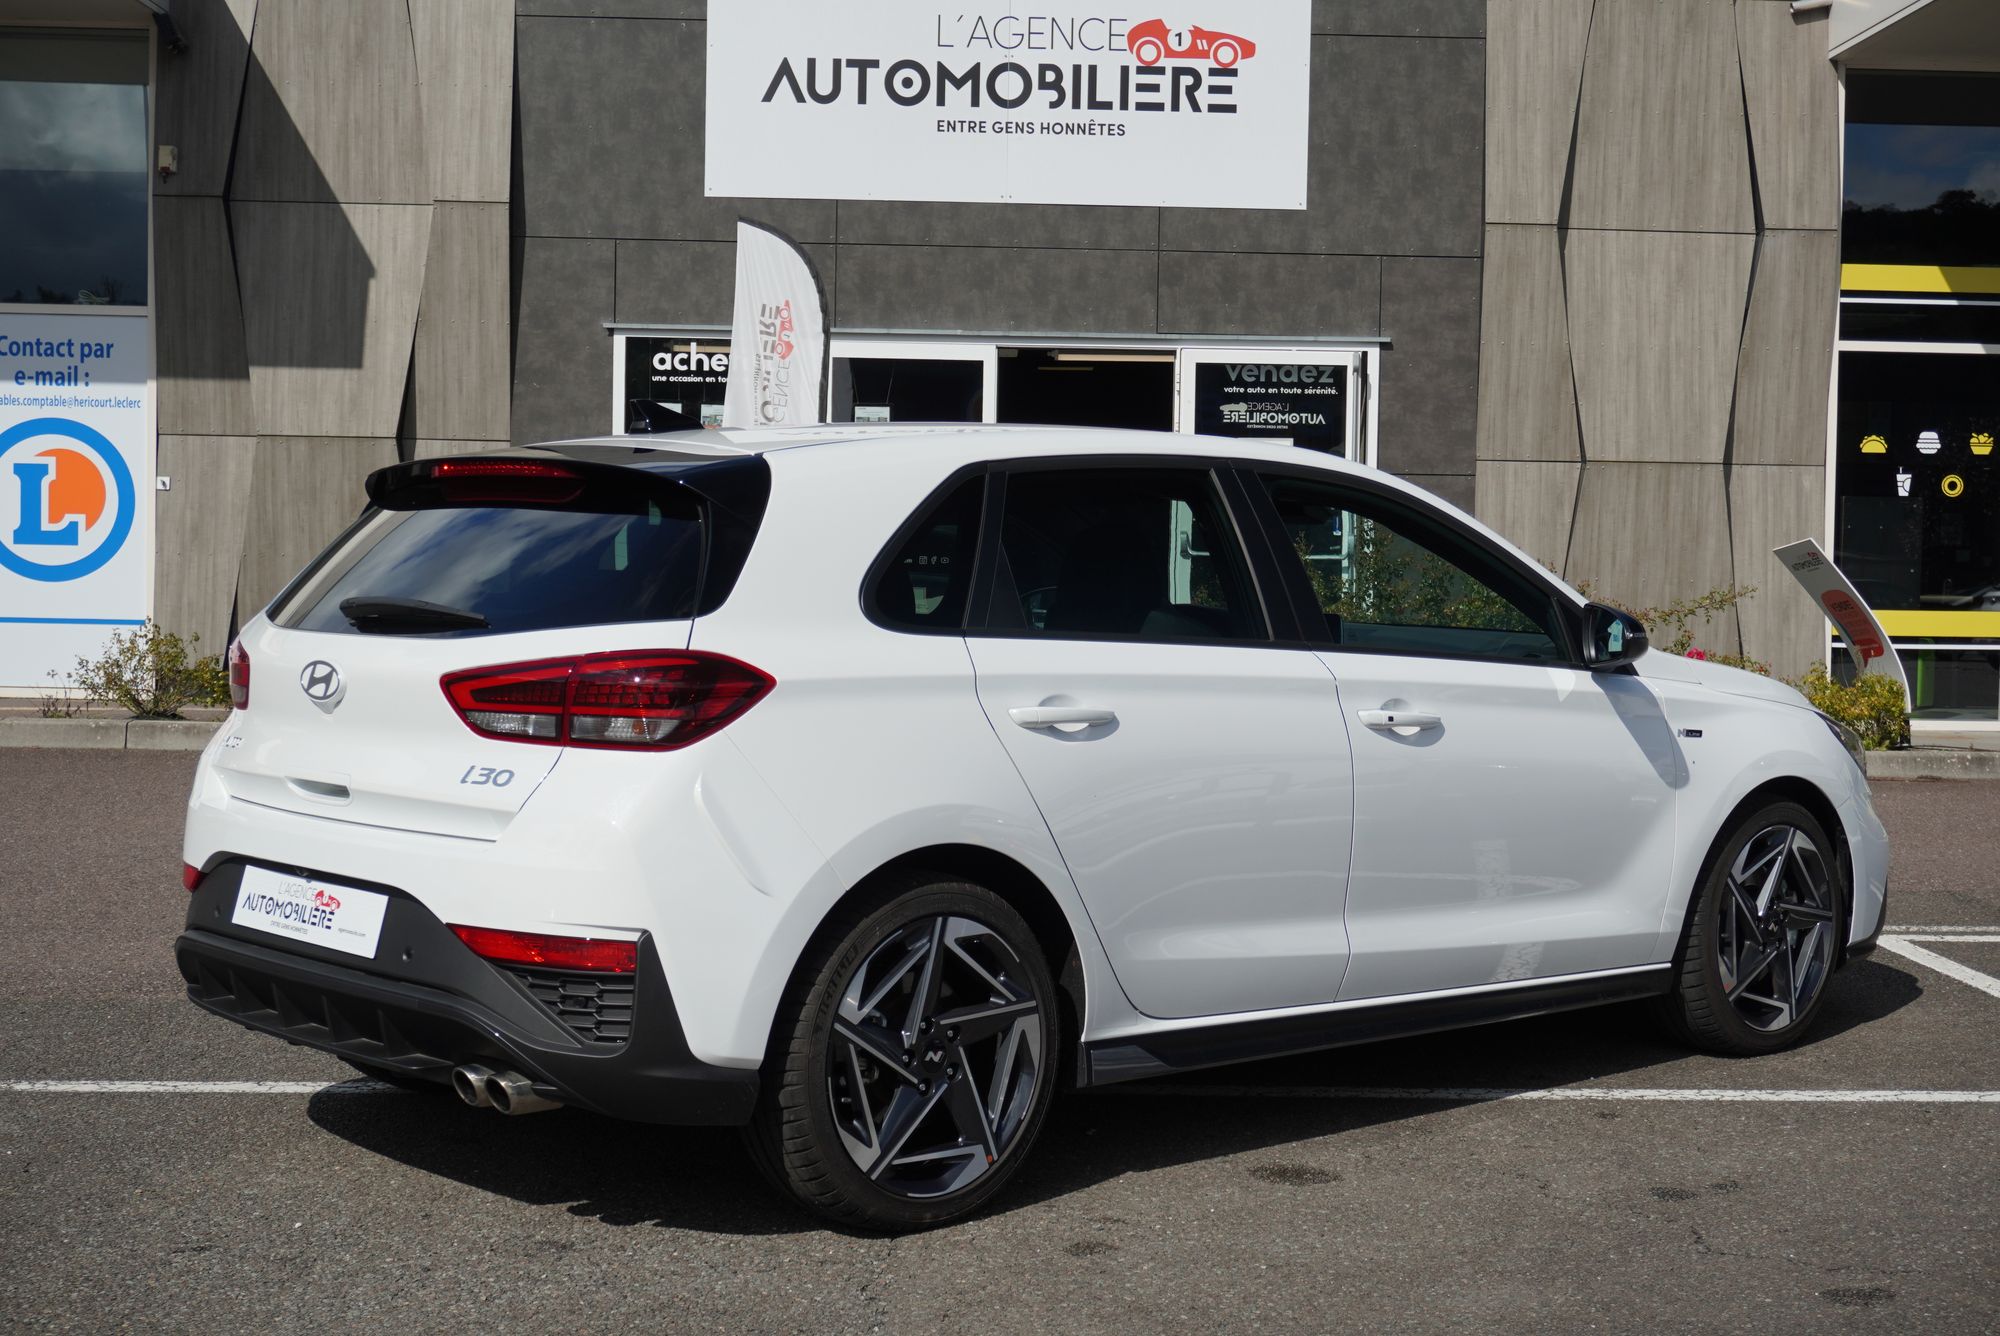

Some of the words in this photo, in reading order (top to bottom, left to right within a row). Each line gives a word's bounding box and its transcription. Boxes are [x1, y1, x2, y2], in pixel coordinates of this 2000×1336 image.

[936, 13, 1128, 52] L'AGENCE
[936, 119, 987, 134] ENTRE
[991, 120, 1035, 135] GENS
[1039, 118, 1127, 136] HONNÊTES
[0, 335, 75, 358] Contact
[79, 341, 114, 364] par
[652, 342, 730, 372] ache
[14, 365, 79, 387] e-mail
[669, 374, 704, 383] occasion
[718, 375, 729, 383] to
[1223, 385, 1245, 394] votre
[1246, 386, 1266, 394] auto
[1280, 386, 1302, 395] toute
[1304, 386, 1339, 395] sérénité.
